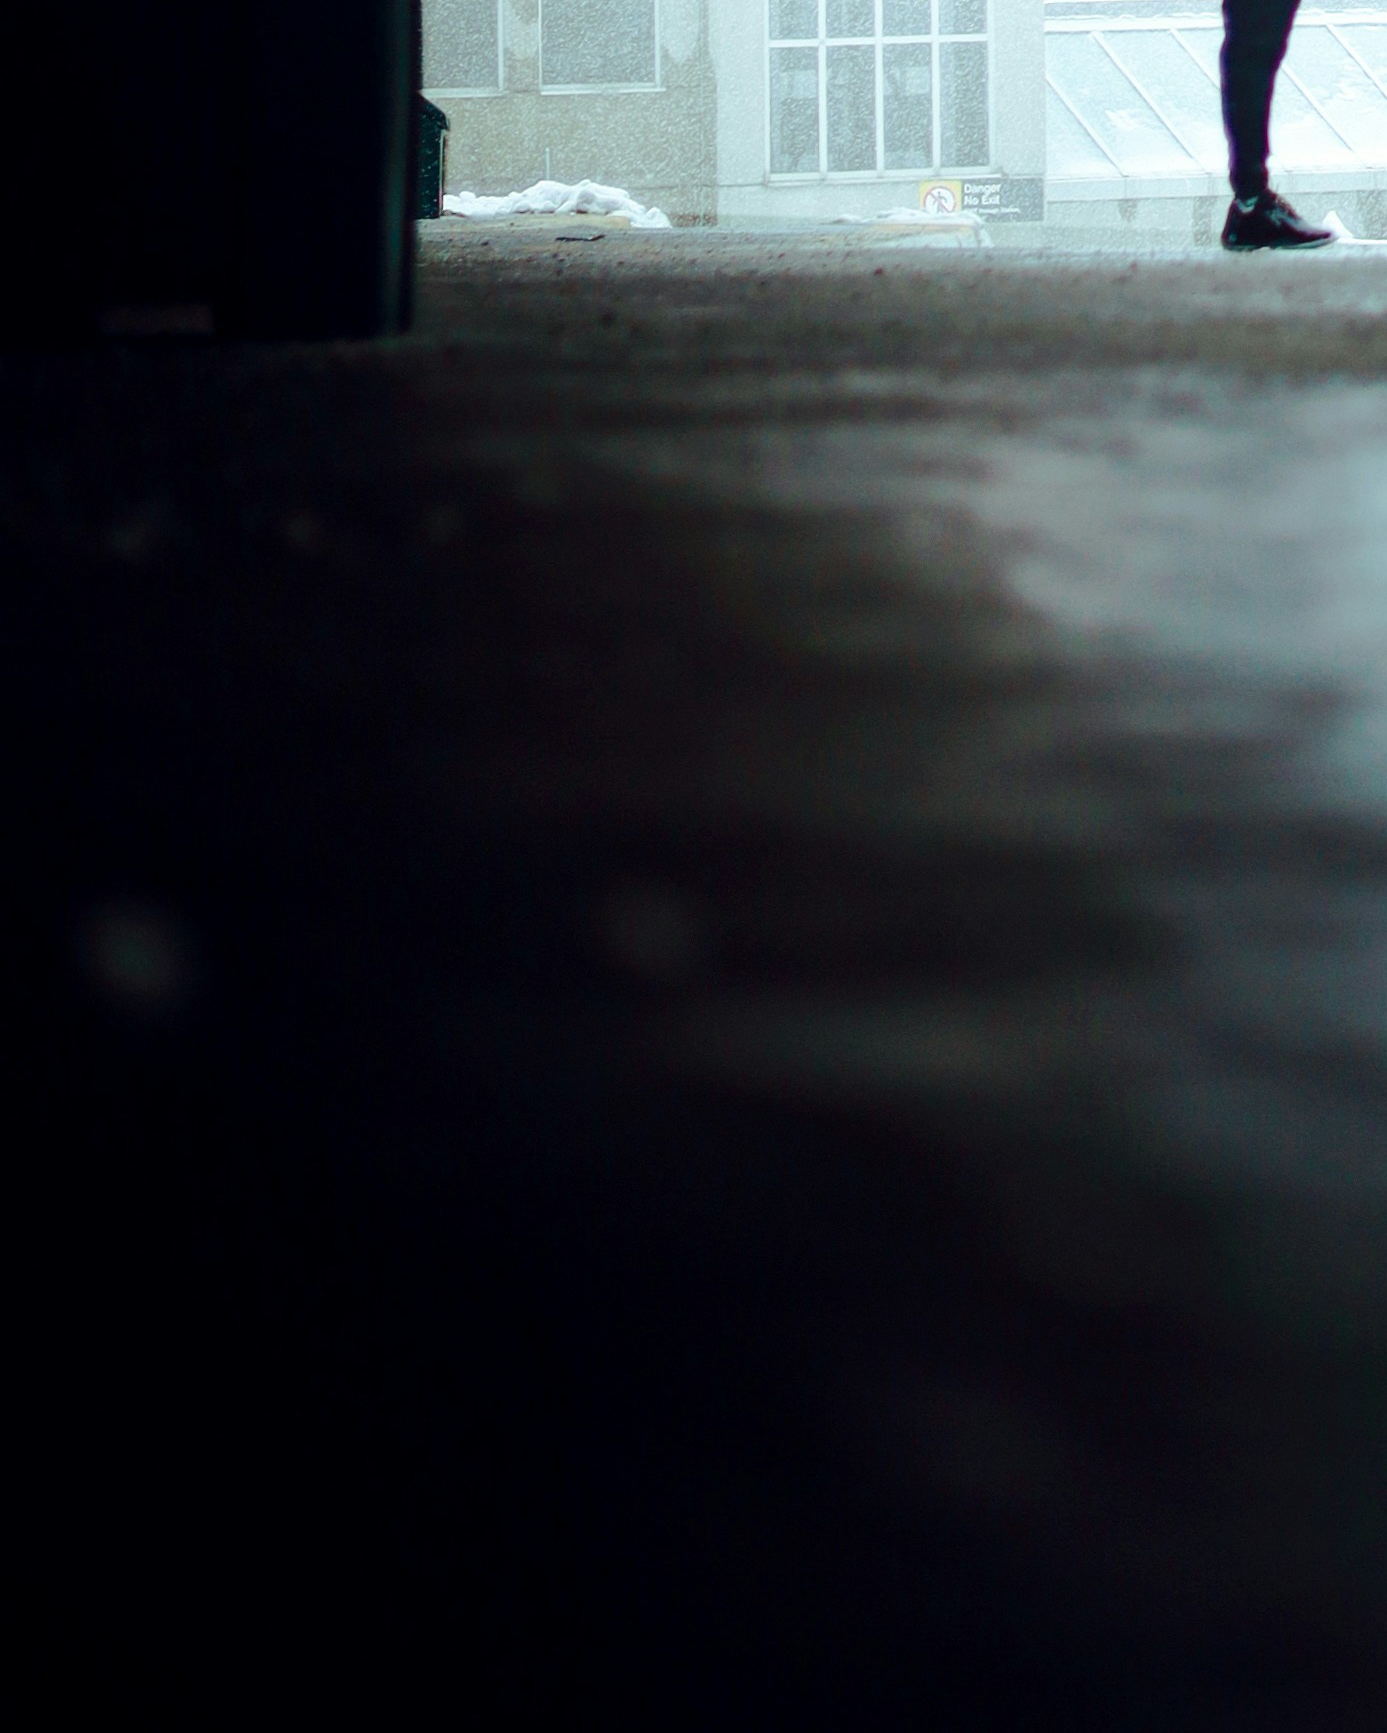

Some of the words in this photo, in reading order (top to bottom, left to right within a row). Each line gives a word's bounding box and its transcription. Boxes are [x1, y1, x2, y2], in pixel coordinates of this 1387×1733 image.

[963, 183, 1002, 197] Danger
[963, 195, 980, 206] No
[982, 194, 1001, 206] Exit
